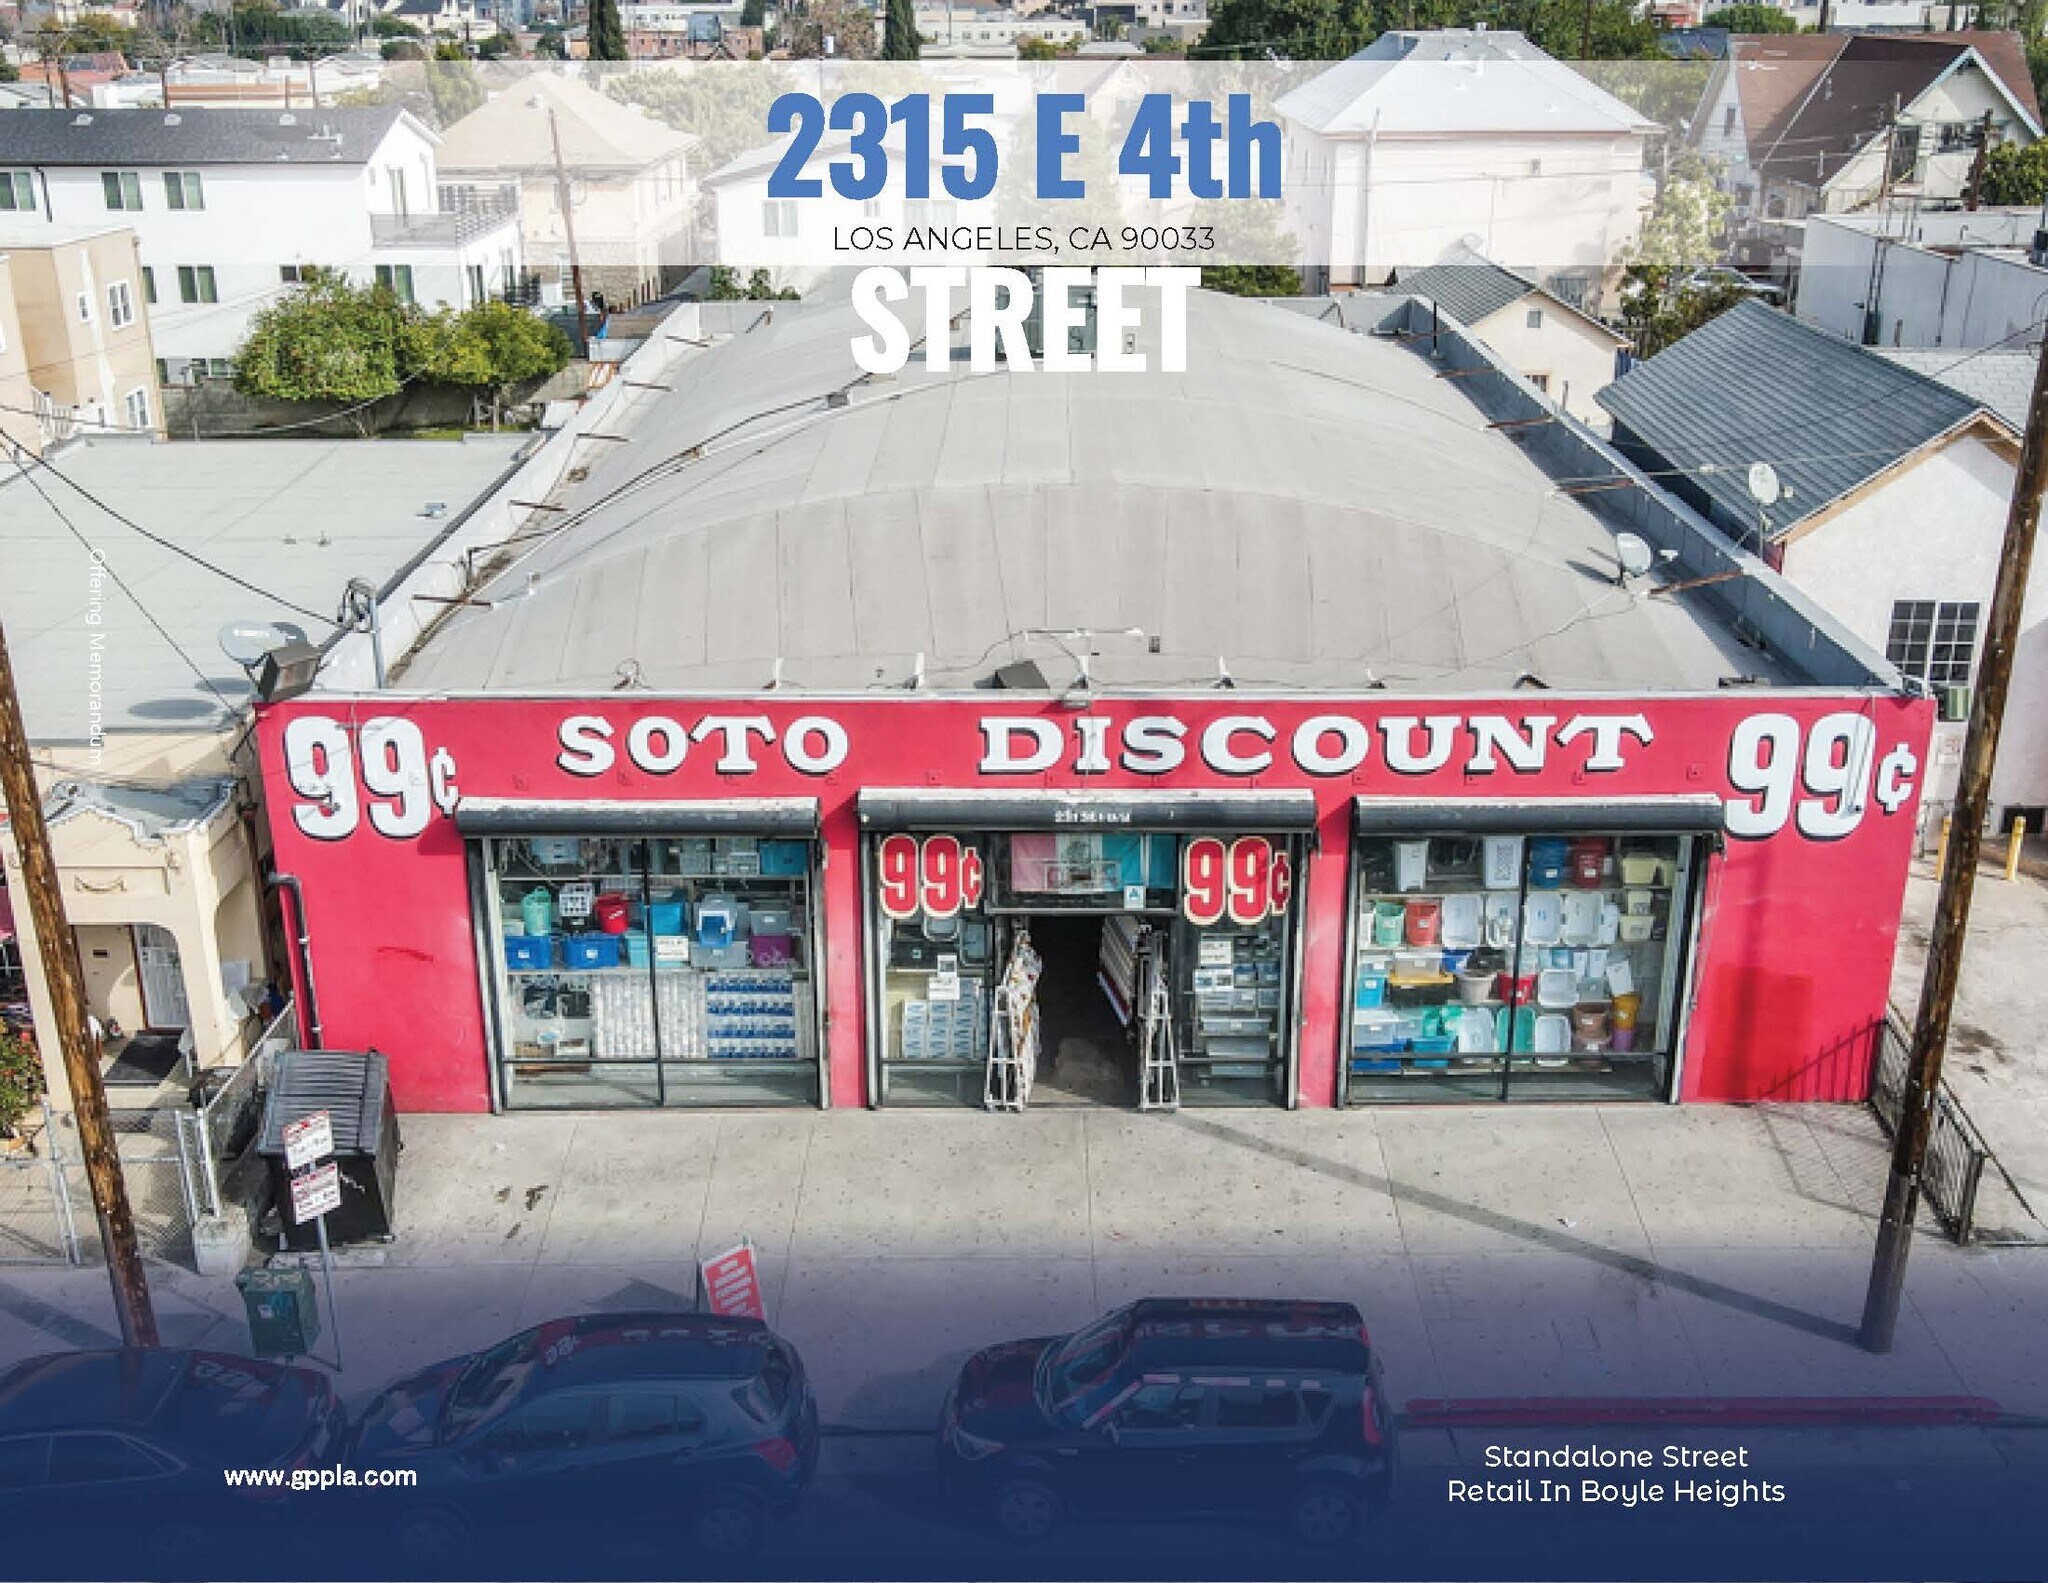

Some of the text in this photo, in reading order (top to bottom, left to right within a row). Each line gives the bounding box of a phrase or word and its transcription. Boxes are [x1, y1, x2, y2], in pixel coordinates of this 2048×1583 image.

[284, 715, 461, 840] 99¢
[557, 714, 1654, 776] SOTO DISCOUNT
[1725, 713, 1918, 841] 99¢
[880, 834, 985, 919] 99¢
[1184, 836, 1292, 925] 99¢
